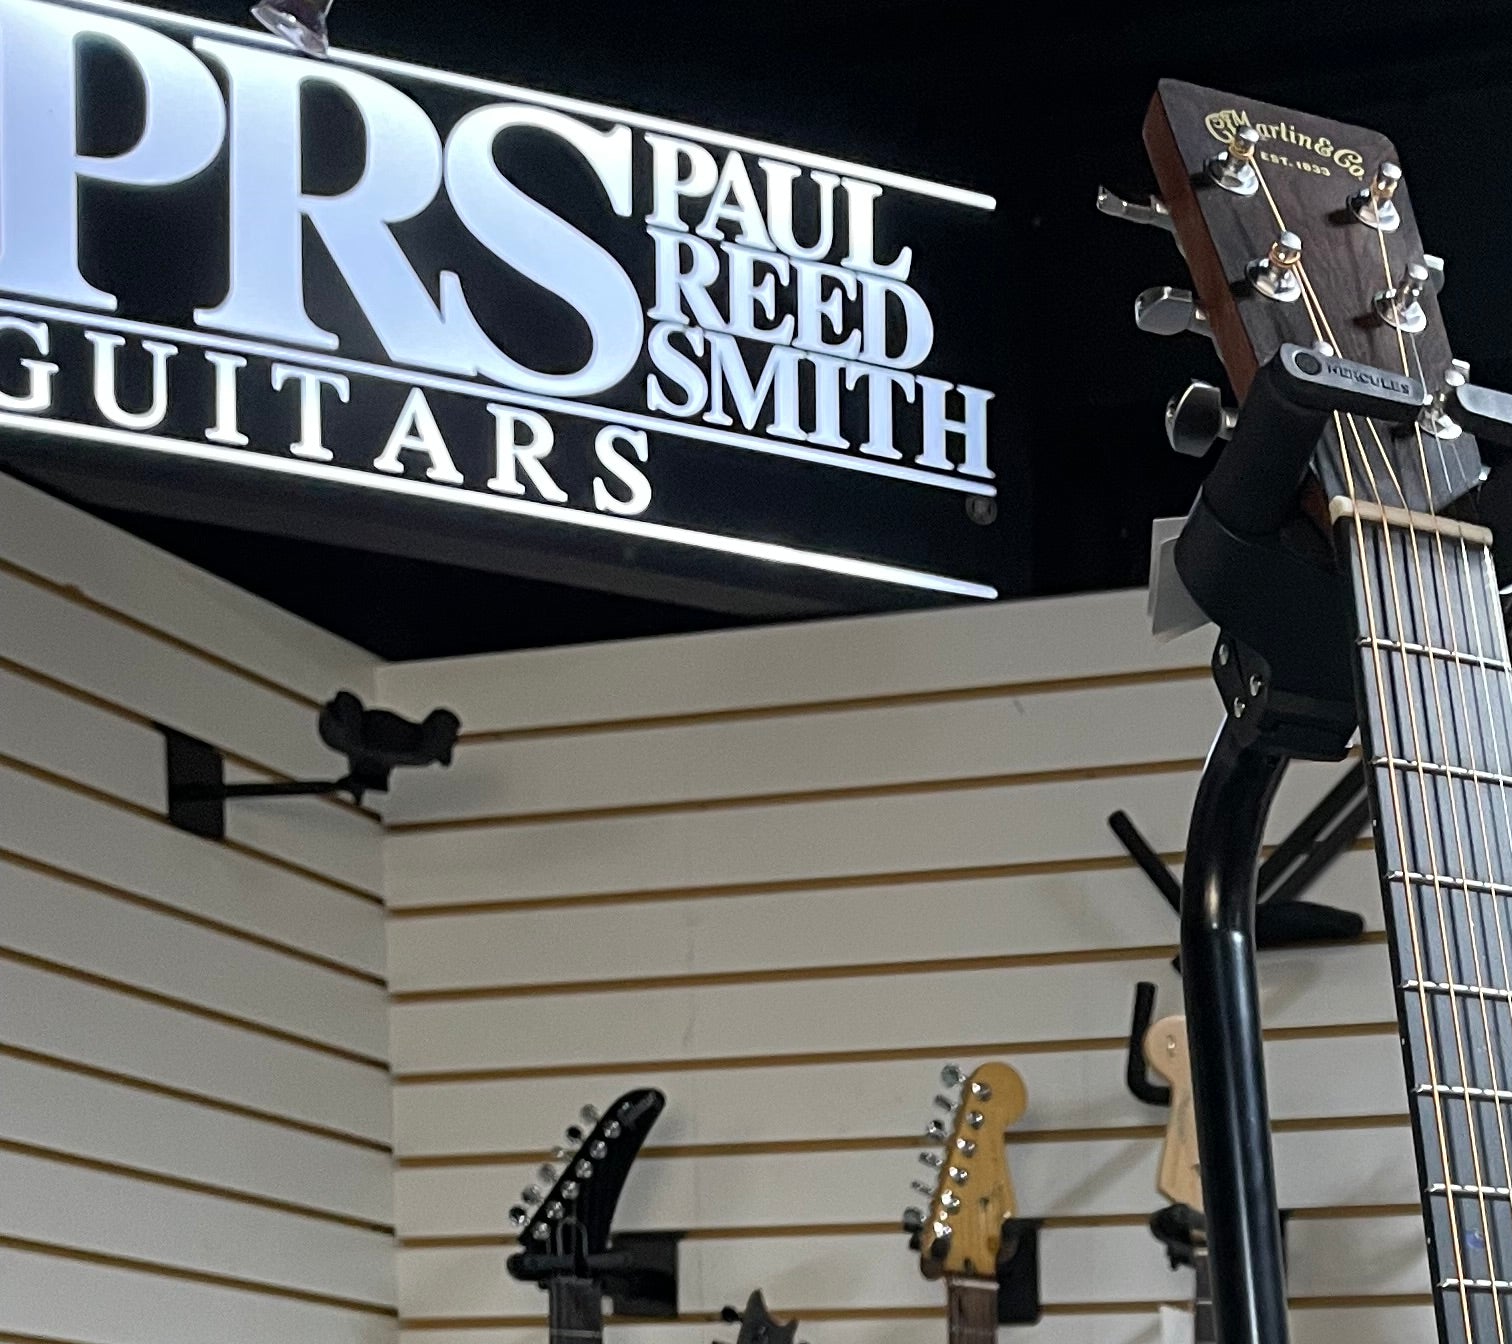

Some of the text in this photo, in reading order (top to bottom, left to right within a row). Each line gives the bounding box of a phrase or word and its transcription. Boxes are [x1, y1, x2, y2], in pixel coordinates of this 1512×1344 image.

[0, 0, 643, 396] PRS
[645, 132, 912, 281] PAUL
[647, 226, 934, 371] REED
[0, 316, 652, 516] GUITARS
[646, 324, 996, 479] SMITH
